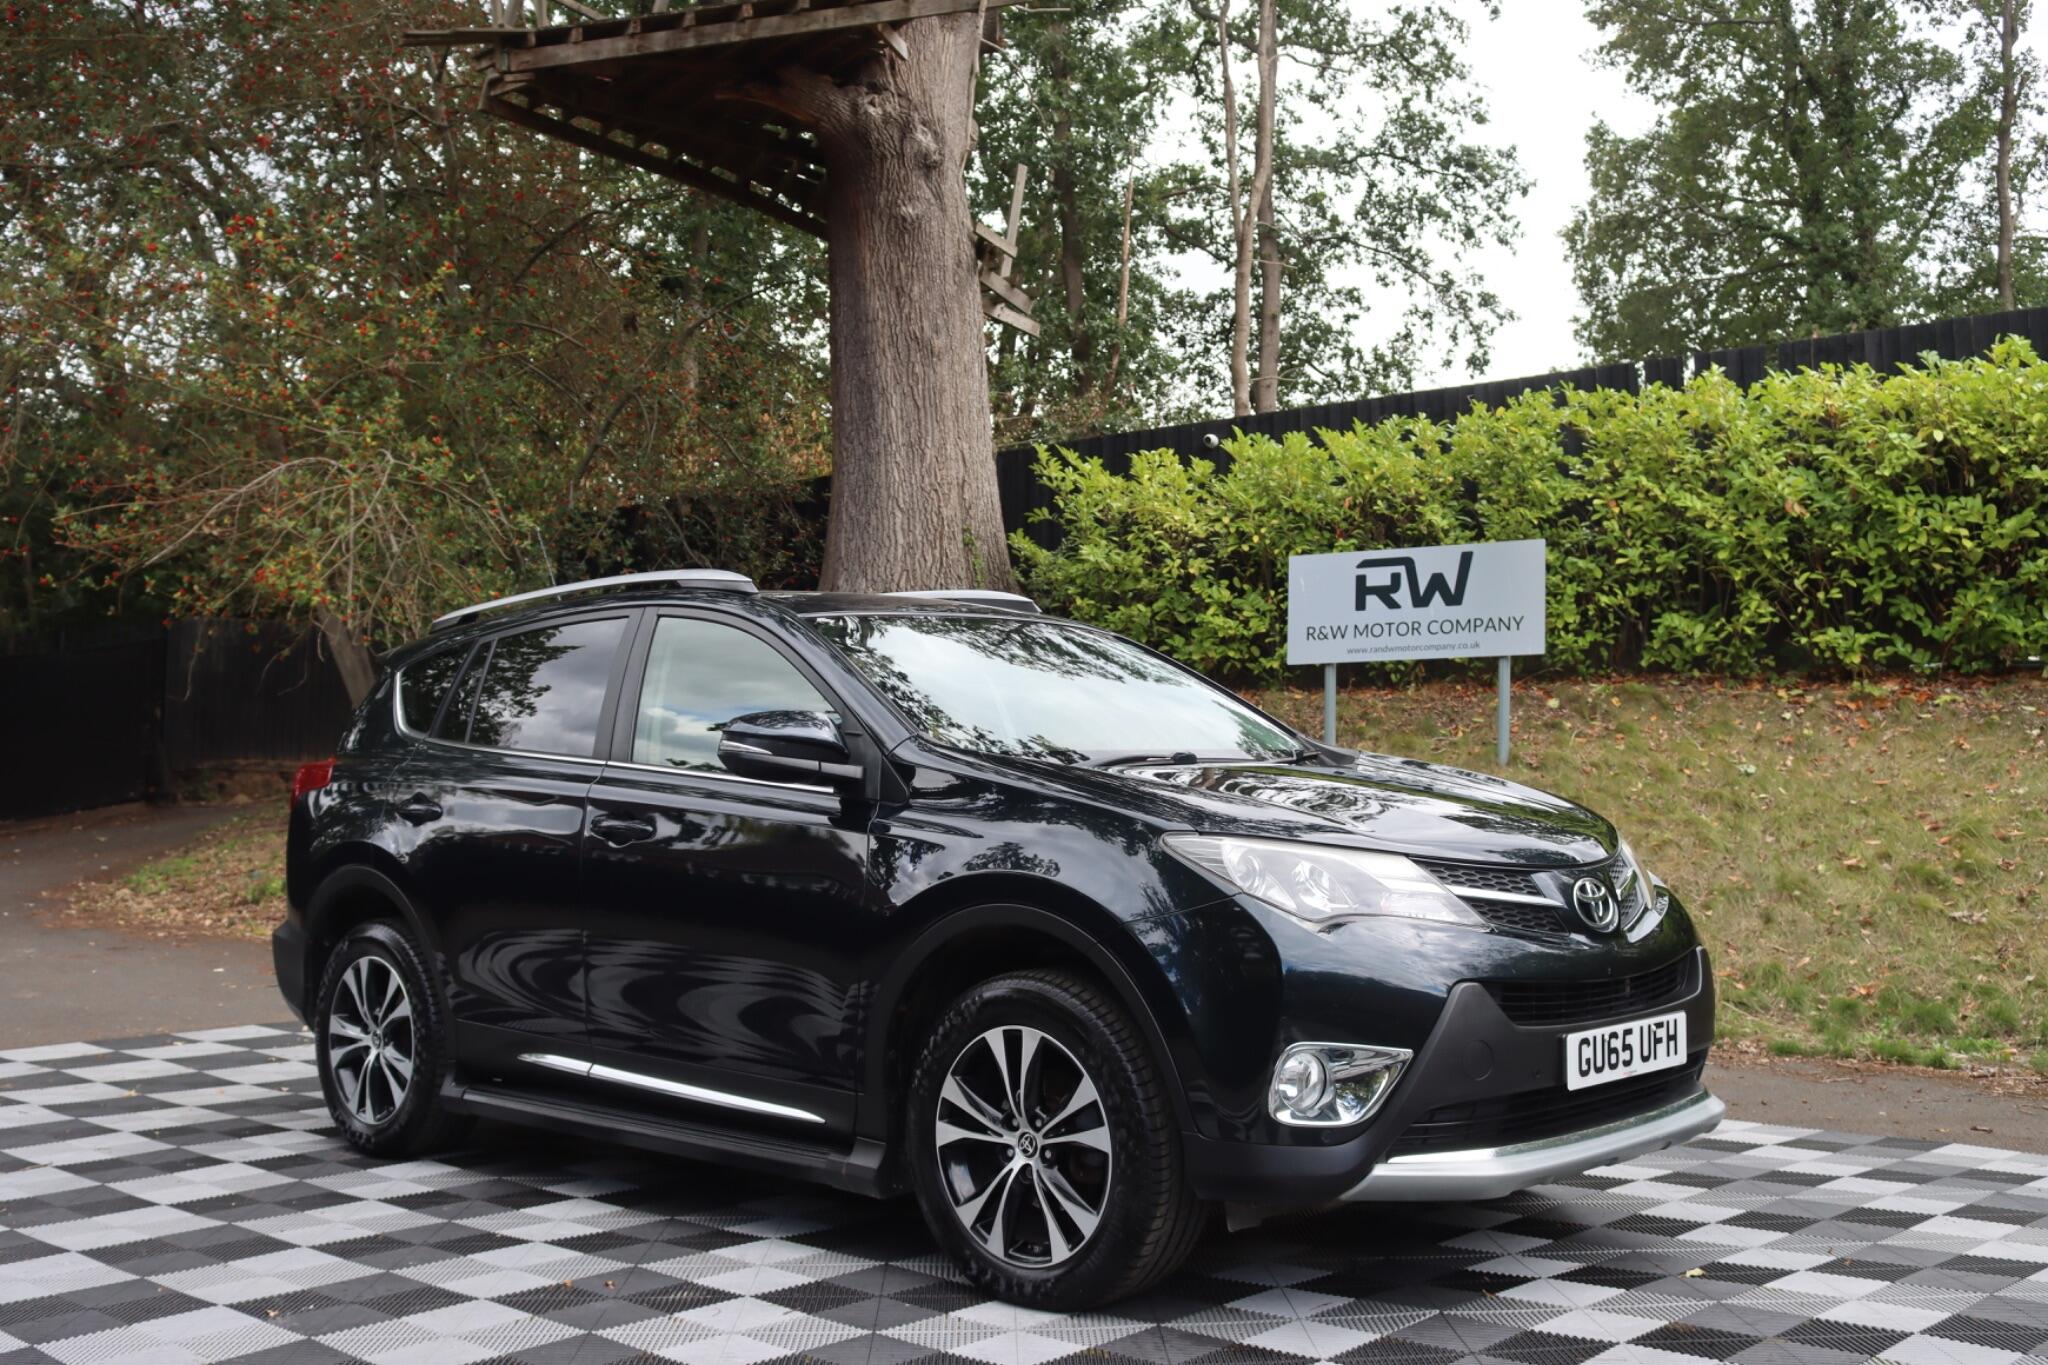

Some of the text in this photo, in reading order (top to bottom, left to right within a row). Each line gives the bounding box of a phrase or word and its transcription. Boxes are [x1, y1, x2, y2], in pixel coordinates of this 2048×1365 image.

[1355, 551, 1474, 611] RW
[1306, 615, 1525, 641] R&W MOTOR COMPANY
[1346, 640, 1480, 655] www.randwmotorcompany.co.uk
[1578, 1018, 1677, 1077] GU65 UFH
